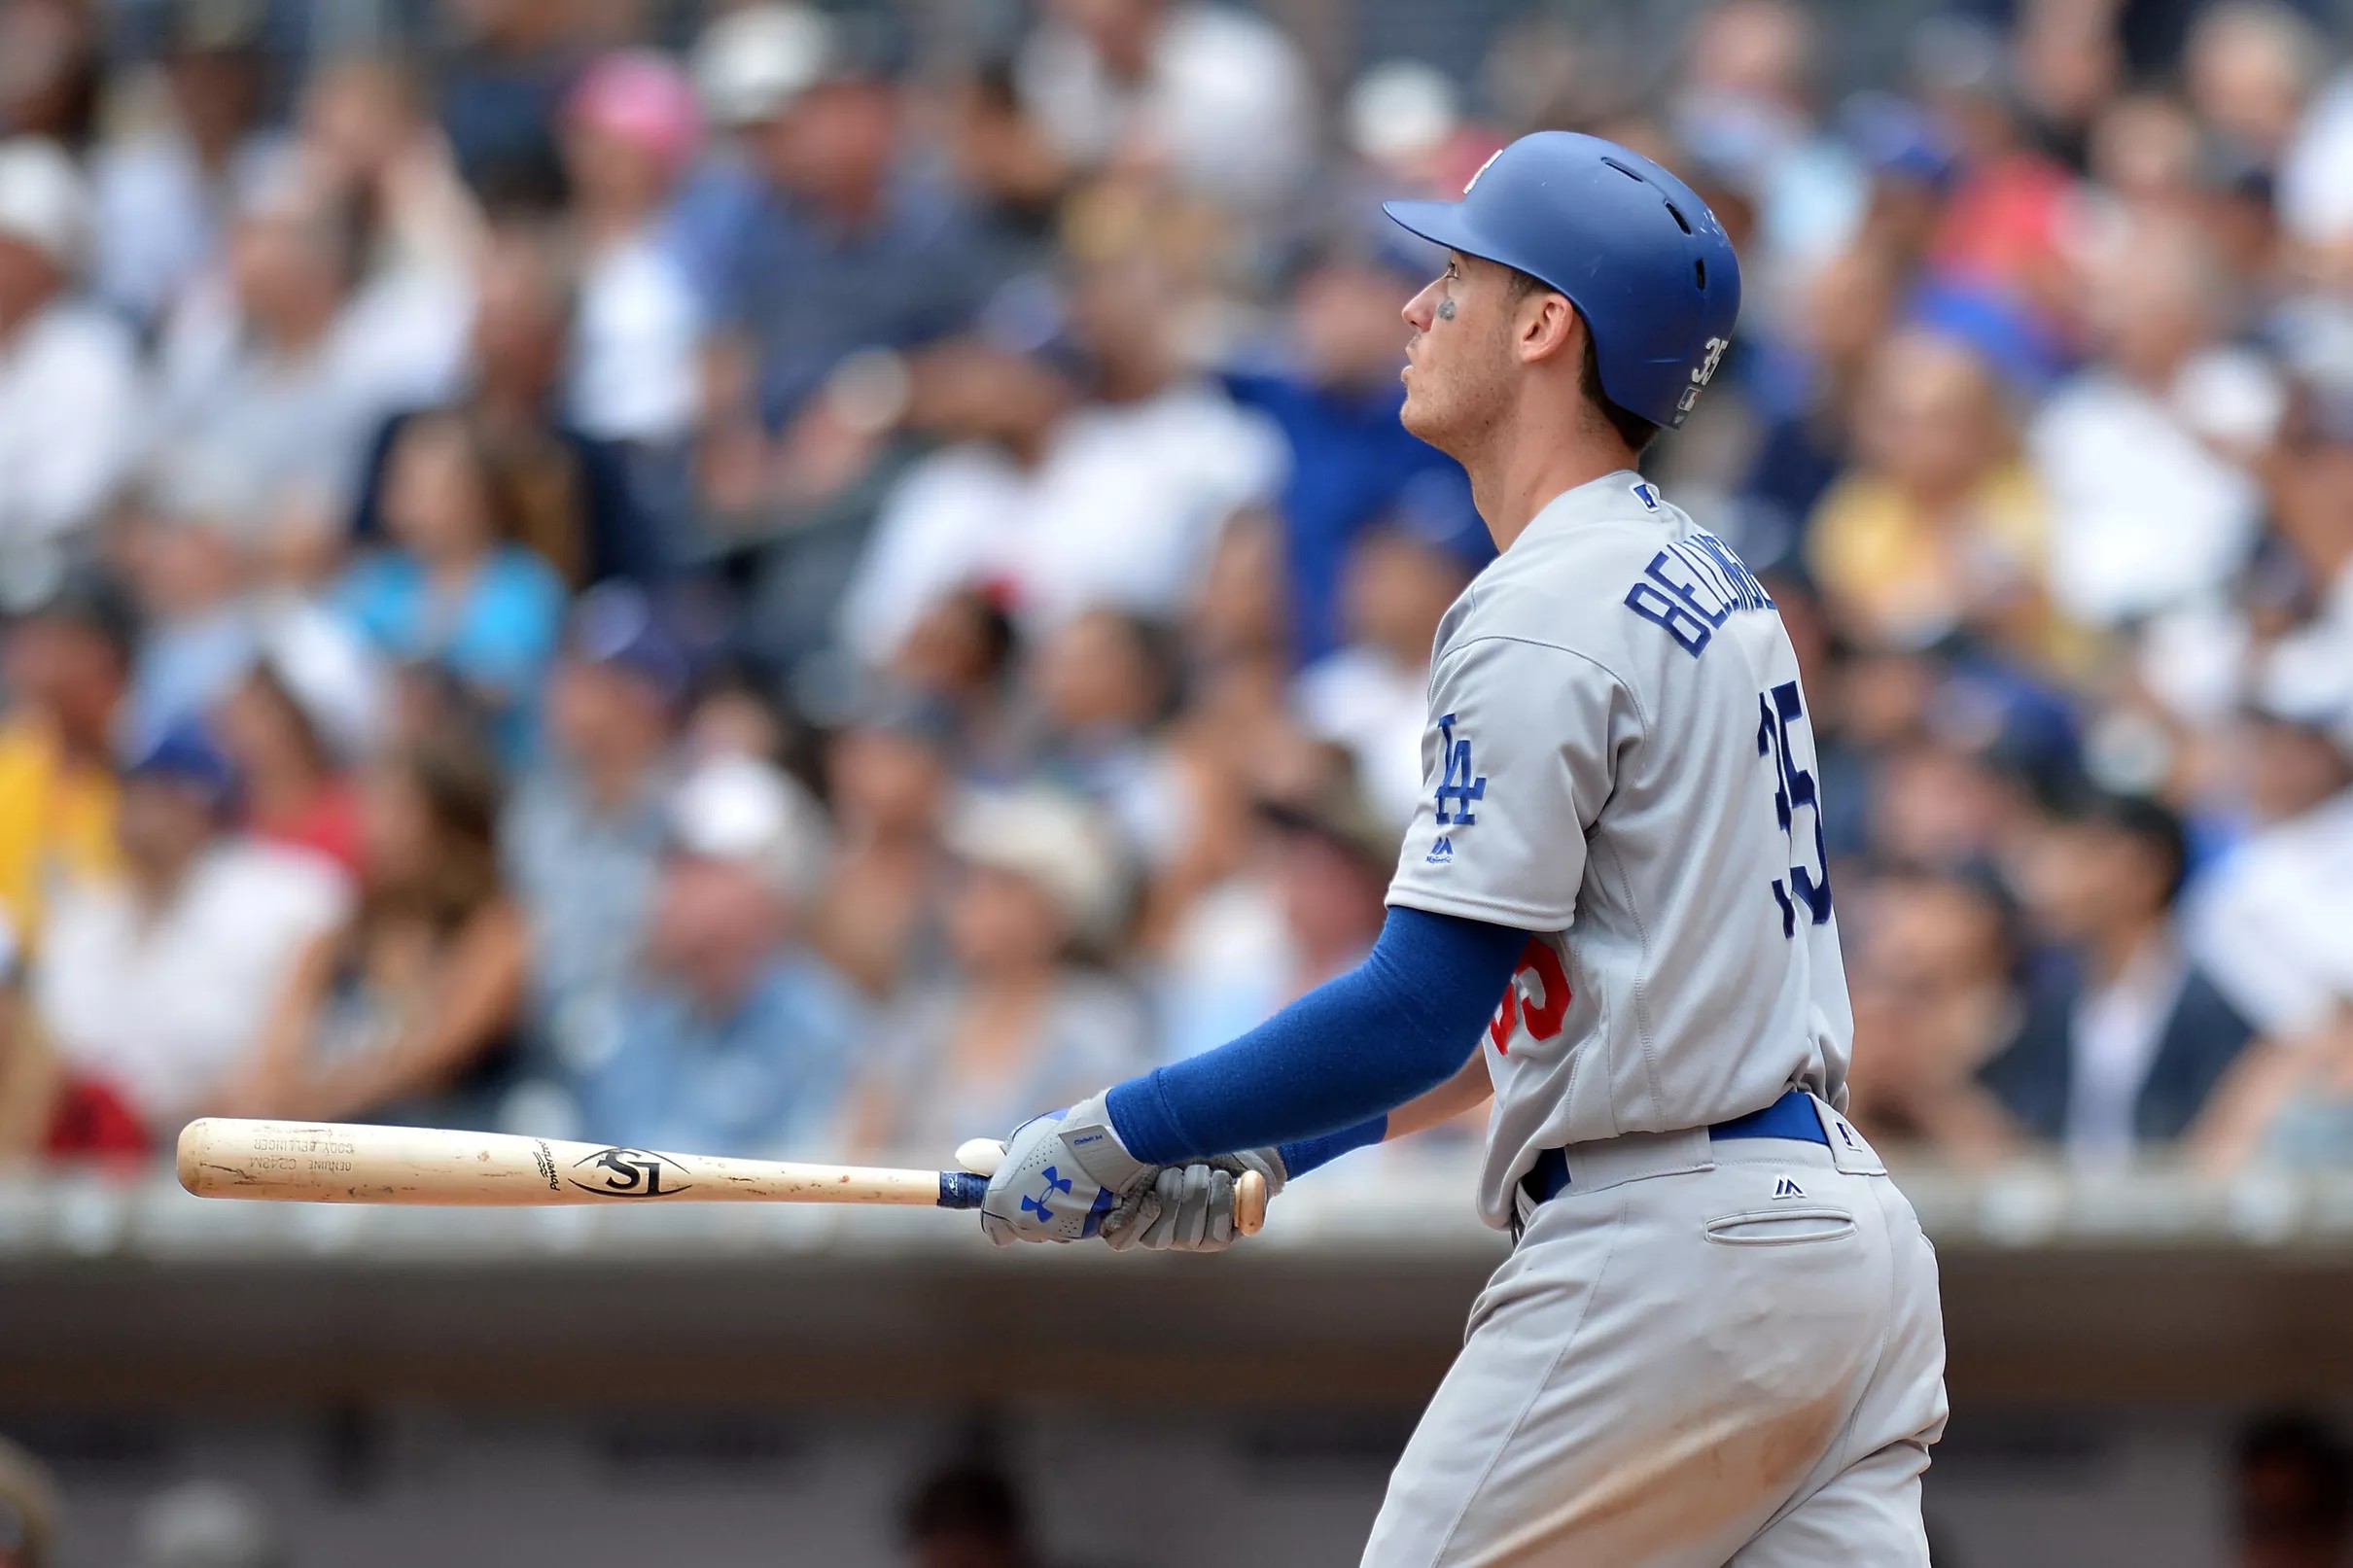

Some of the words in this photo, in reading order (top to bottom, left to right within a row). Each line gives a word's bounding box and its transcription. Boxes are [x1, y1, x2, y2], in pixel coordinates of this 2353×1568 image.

[1692, 337, 1729, 385] 35
[1434, 713, 1487, 825] LA
[1758, 681, 1834, 939] 35
[308, 1159, 352, 1171] GENUINE
